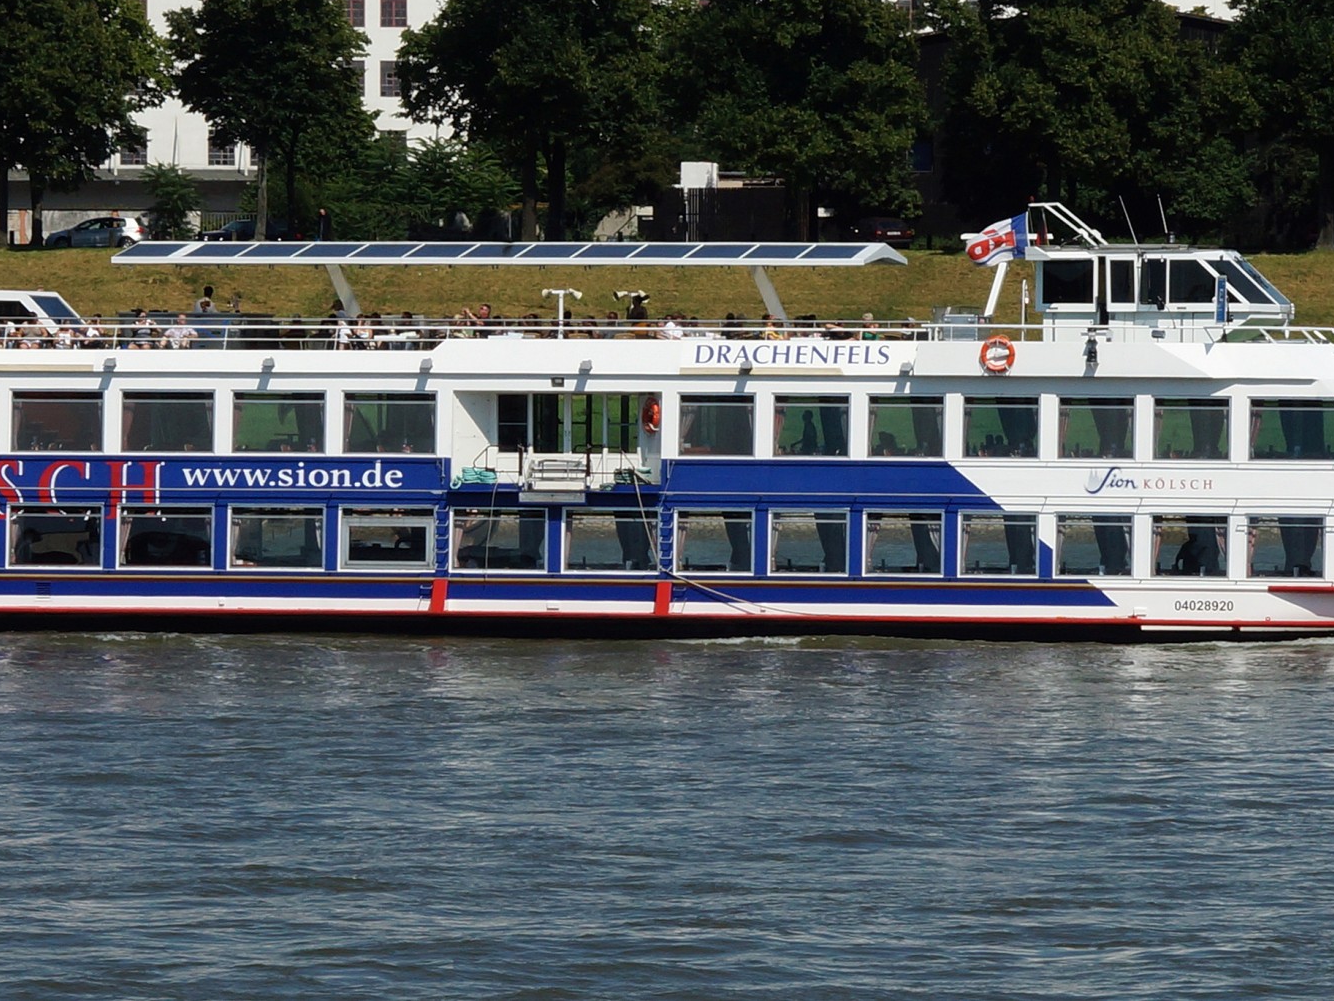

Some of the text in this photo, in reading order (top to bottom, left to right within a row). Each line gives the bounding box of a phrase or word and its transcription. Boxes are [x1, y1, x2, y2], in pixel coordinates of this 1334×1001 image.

[695, 344, 891, 366] DRACHENFELS
[182, 459, 404, 488] www.sion.de
[1084, 466, 1214, 495] Sion KÖLSCH
[1174, 600, 1234, 612] 04028920
